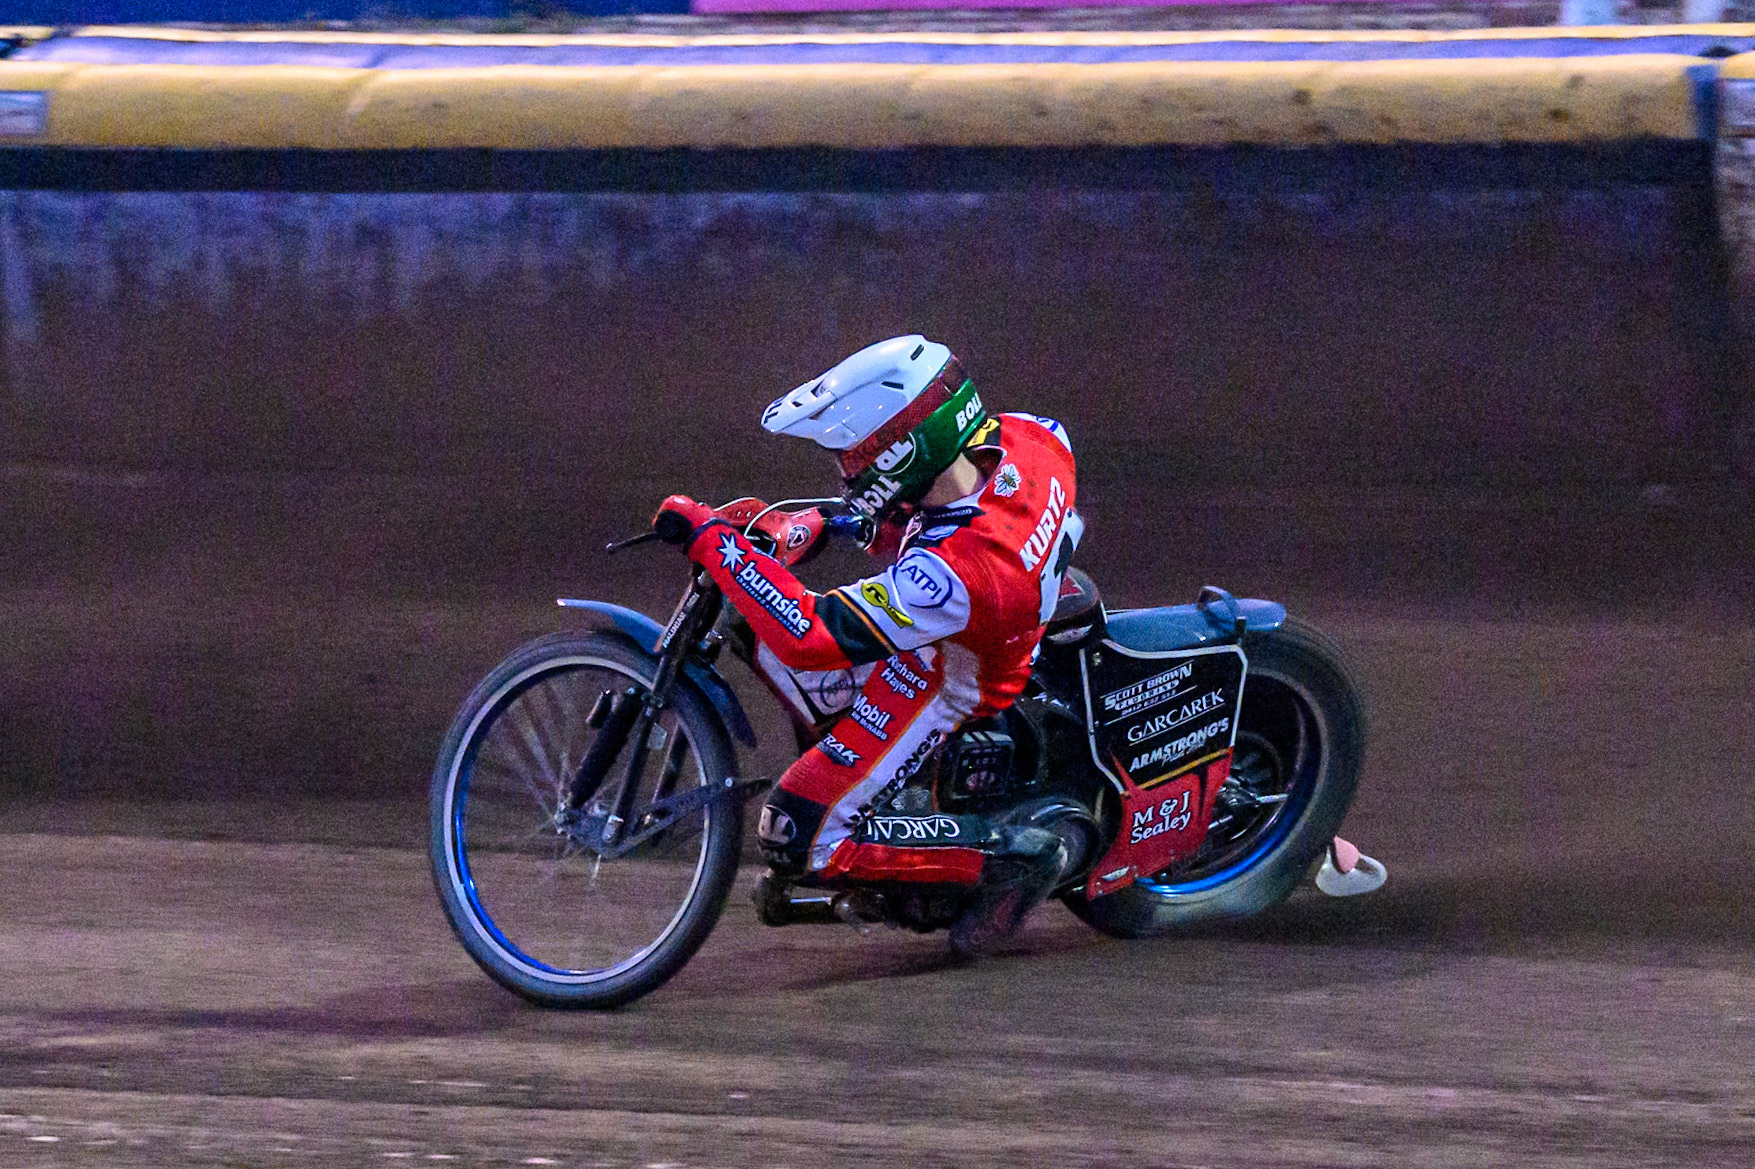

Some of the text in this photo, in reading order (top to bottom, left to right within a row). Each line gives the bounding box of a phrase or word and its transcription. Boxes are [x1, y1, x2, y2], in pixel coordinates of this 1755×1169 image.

[880, 667, 916, 699] Hayes
[1127, 688, 1224, 742] GARCAREK
[1129, 717, 1229, 773] ARMSTRONG'S
[1130, 812, 1191, 844] Sealey
[1133, 791, 1191, 828] M & J
